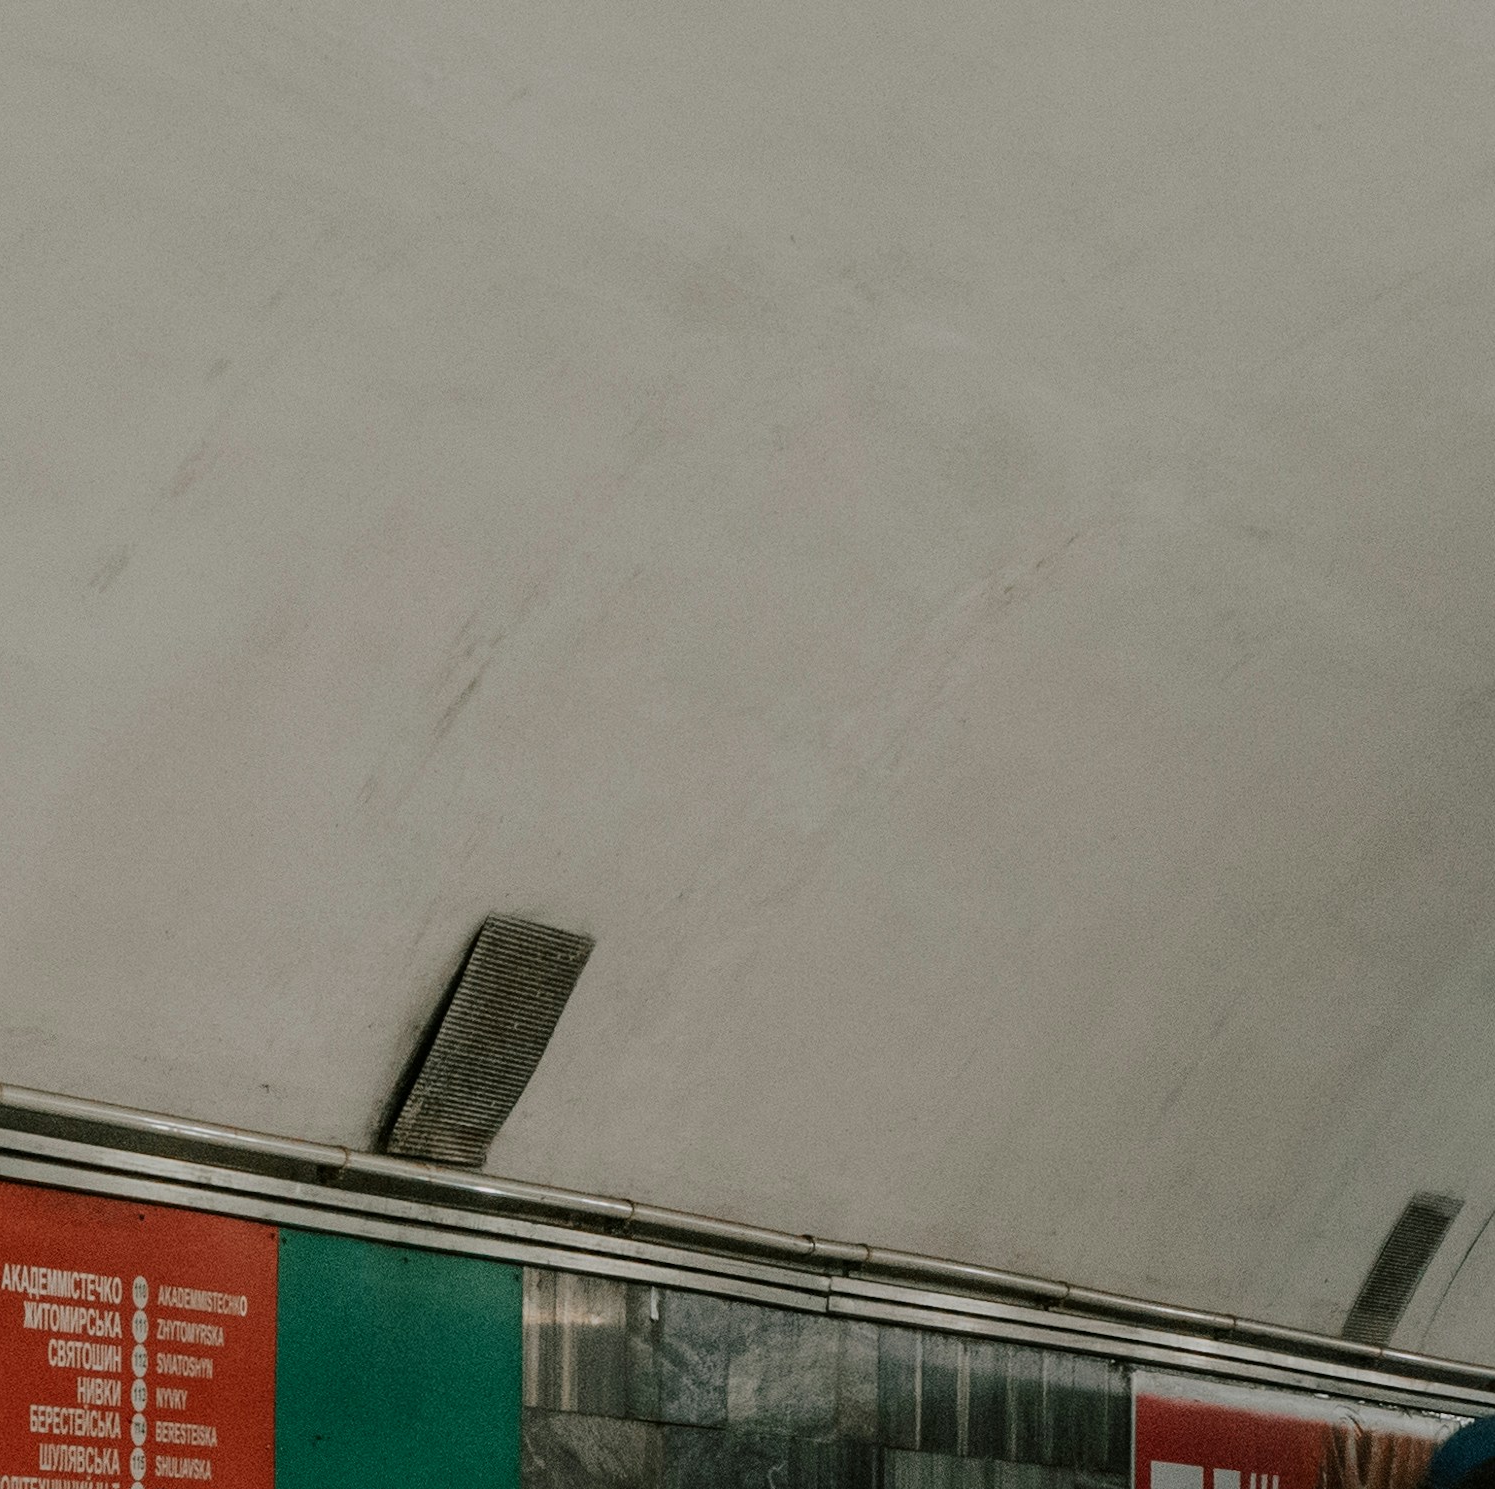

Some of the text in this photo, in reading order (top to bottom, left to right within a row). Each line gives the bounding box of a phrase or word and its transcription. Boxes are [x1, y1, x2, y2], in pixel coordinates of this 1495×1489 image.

[1, 1263, 122, 1305] АКАДЕММІСТЕЧКО
[23, 1301, 122, 1338] ЖИТОМИРСЬКА
[156, 1318, 224, 1347] ZHYTOMYRSKA
[48, 1338, 122, 1373] СВЯТОШИН
[156, 1352, 213, 1379] SVIATOSHYN
[77, 1376, 121, 1406] НИВКИ
[156, 1387, 188, 1410] NYVKY
[29, 1403, 122, 1439] БЕРЕСТЕЙСЬКА
[156, 1421, 217, 1447] BERESTEISKA
[39, 1443, 120, 1475] ШУЛЯВСЬКА
[155, 1455, 212, 1480] SHULIAVSKA
